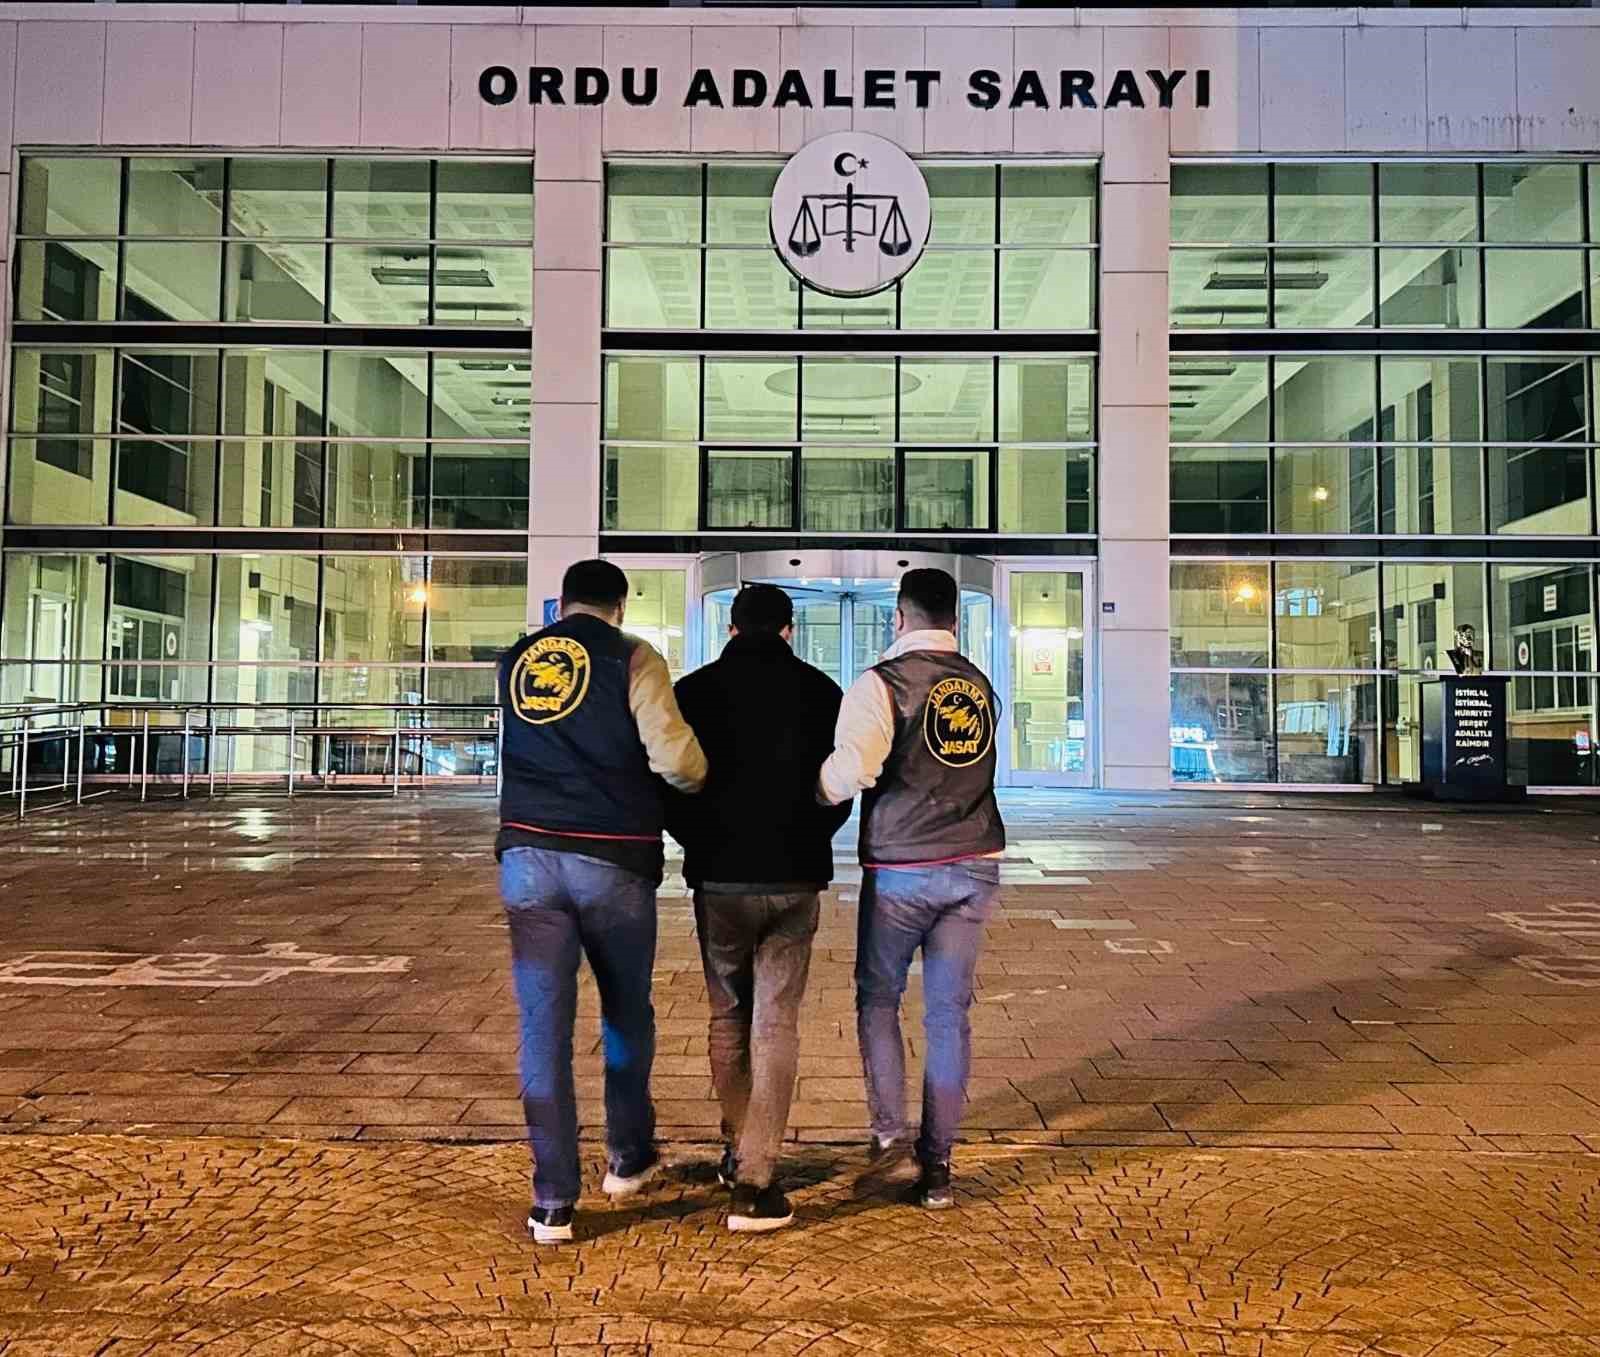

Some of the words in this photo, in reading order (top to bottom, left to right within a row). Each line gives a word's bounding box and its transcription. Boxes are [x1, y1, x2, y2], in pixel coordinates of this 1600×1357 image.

[478, 65, 658, 106] ORDU
[682, 68, 942, 109] ADALET
[967, 69, 1210, 111] SARAYI
[930, 680, 986, 710] JANDARMA
[940, 740, 978, 754] JASAT
